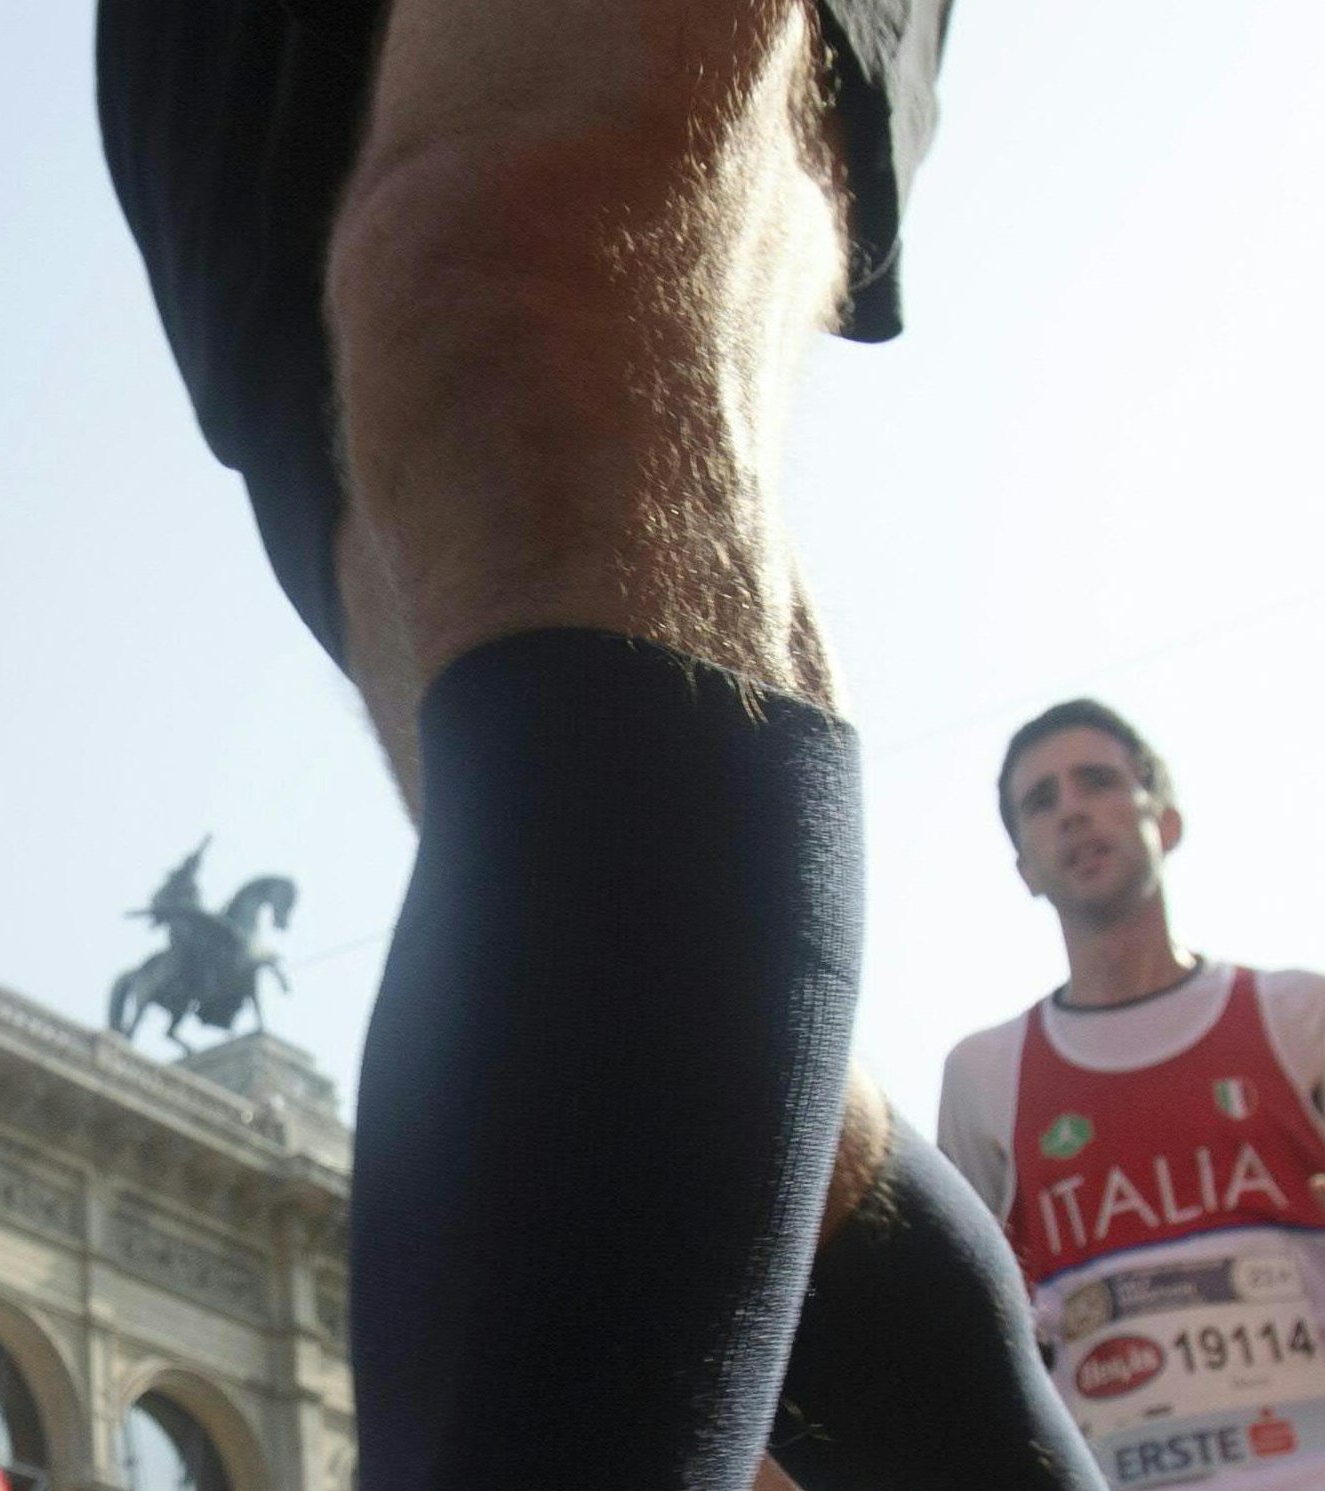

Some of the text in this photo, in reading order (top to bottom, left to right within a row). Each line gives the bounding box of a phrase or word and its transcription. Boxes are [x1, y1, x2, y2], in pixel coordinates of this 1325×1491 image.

[1038, 1145, 1289, 1255] ITALIA
[1173, 1317, 1316, 1375] 19114
[1114, 1424, 1246, 1482] ERSTE
